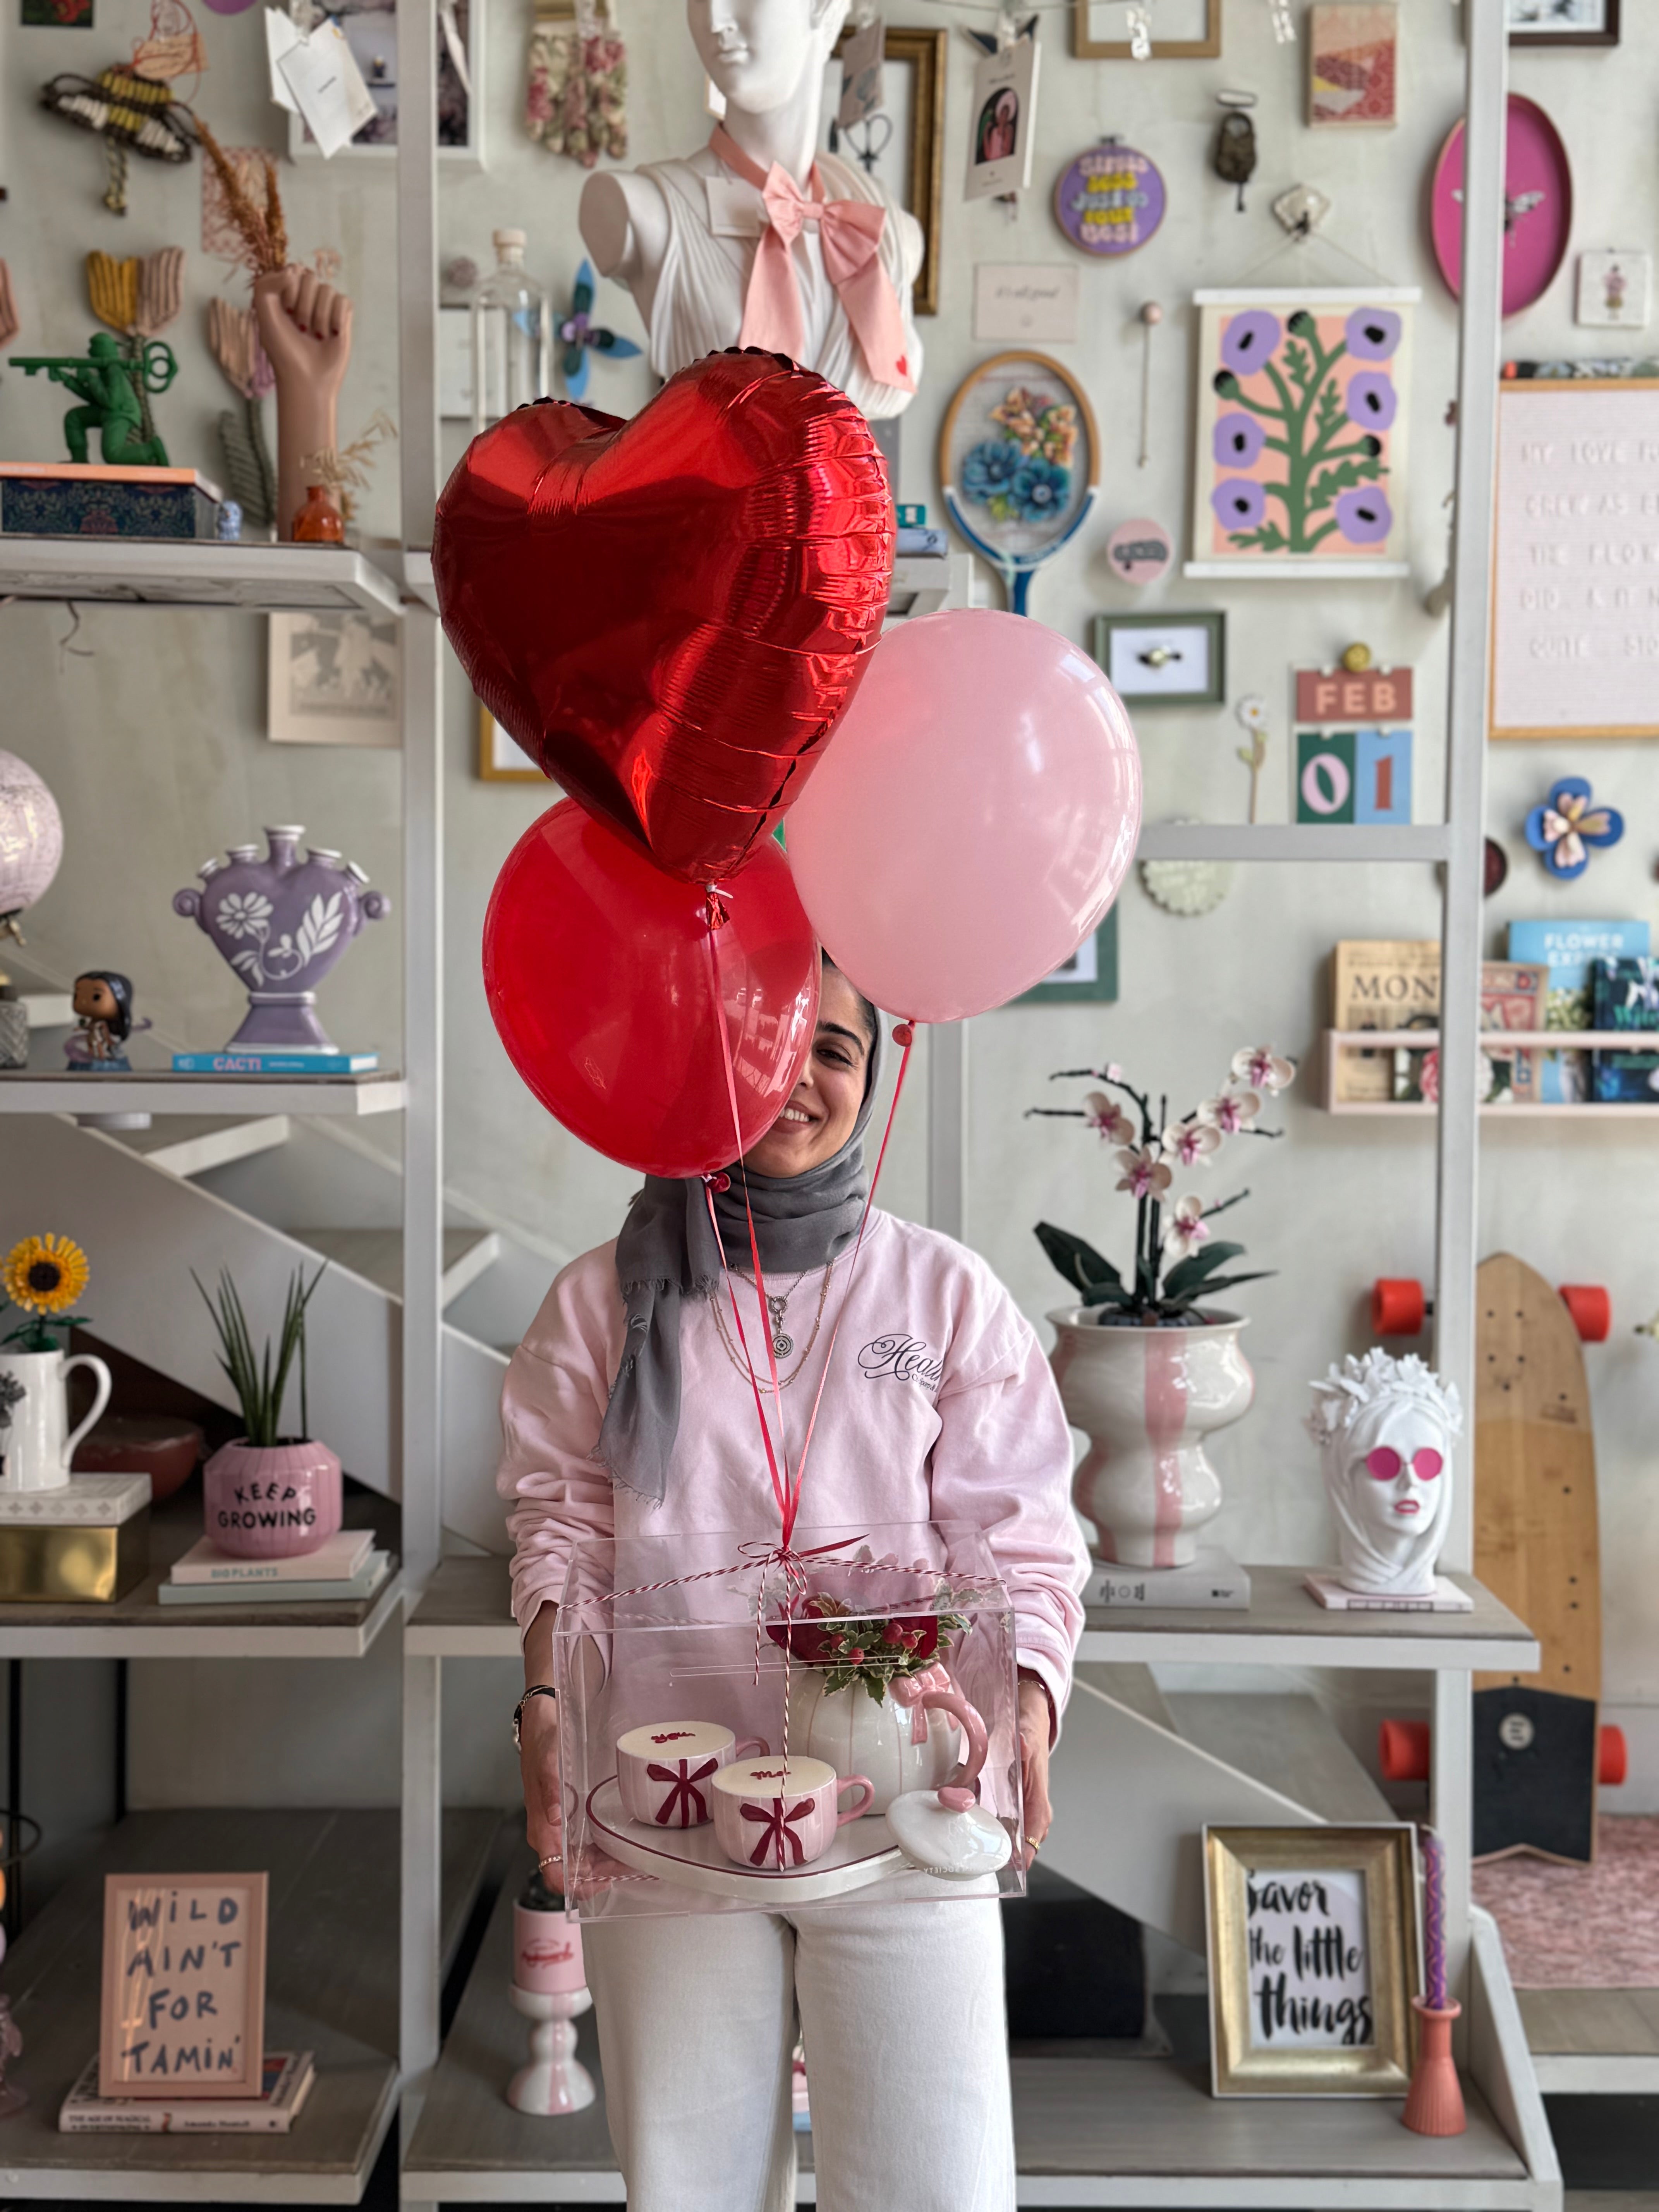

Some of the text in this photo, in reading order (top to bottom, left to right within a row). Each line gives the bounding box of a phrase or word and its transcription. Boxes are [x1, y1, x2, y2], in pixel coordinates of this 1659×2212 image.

[1315, 682, 1396, 714] FEB
[1300, 752, 1393, 814] 01
[1544, 934, 1624, 950] FLOWER
[213, 1057, 261, 1072] CACTI
[234, 1481, 297, 1506] KEEP
[218, 1507, 316, 1529] GROWING
[232, 1567, 278, 1578] PLANTS
[127, 1941, 241, 1976] AIN'T
[1249, 1925, 1364, 1982] the little
[149, 1988, 217, 2030] FOR
[1254, 1972, 1373, 2045] things
